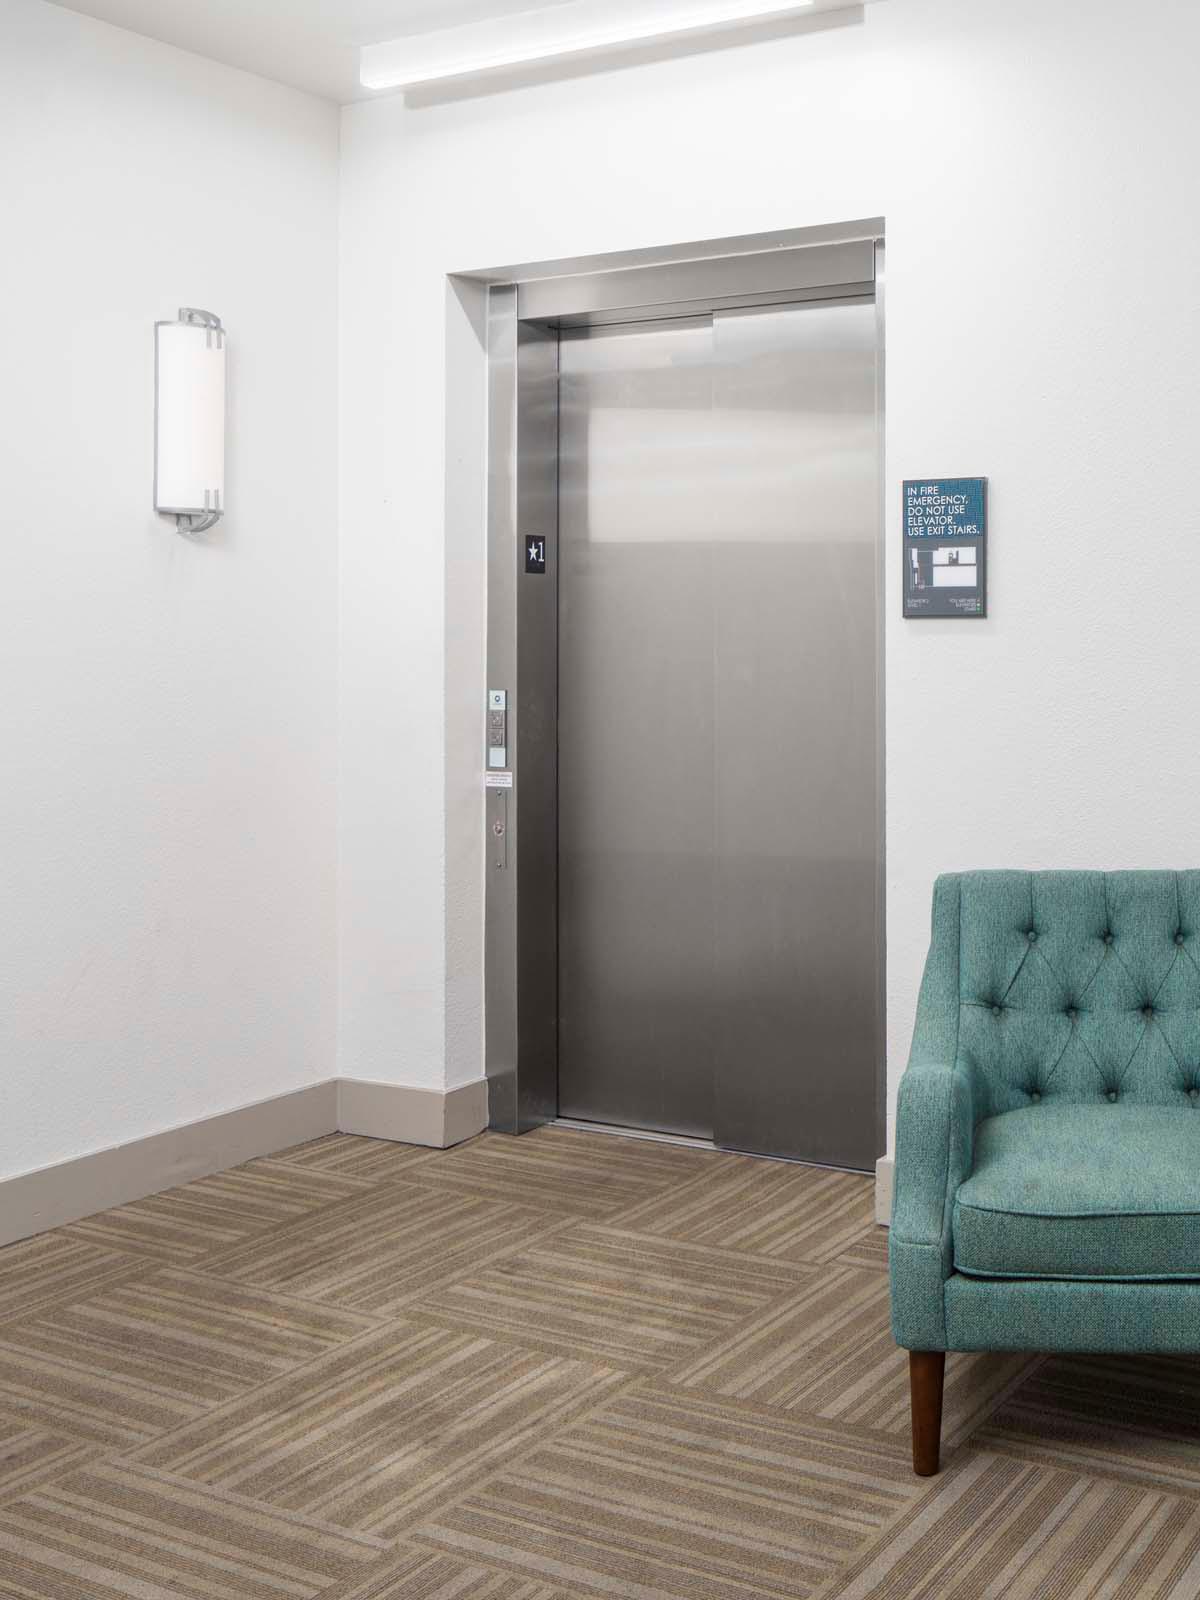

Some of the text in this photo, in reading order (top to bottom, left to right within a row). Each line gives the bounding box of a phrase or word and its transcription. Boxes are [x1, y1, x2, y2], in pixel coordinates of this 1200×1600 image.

[907, 486, 939, 496] IN FIRE
[908, 495, 969, 505] EMERGENCY,
[908, 505, 965, 516] DO NOT USE
[908, 516, 956, 526] ELEVATOR.
[908, 525, 980, 536] USE EXIT STAIRS.
[538, 541, 545, 562] 1
